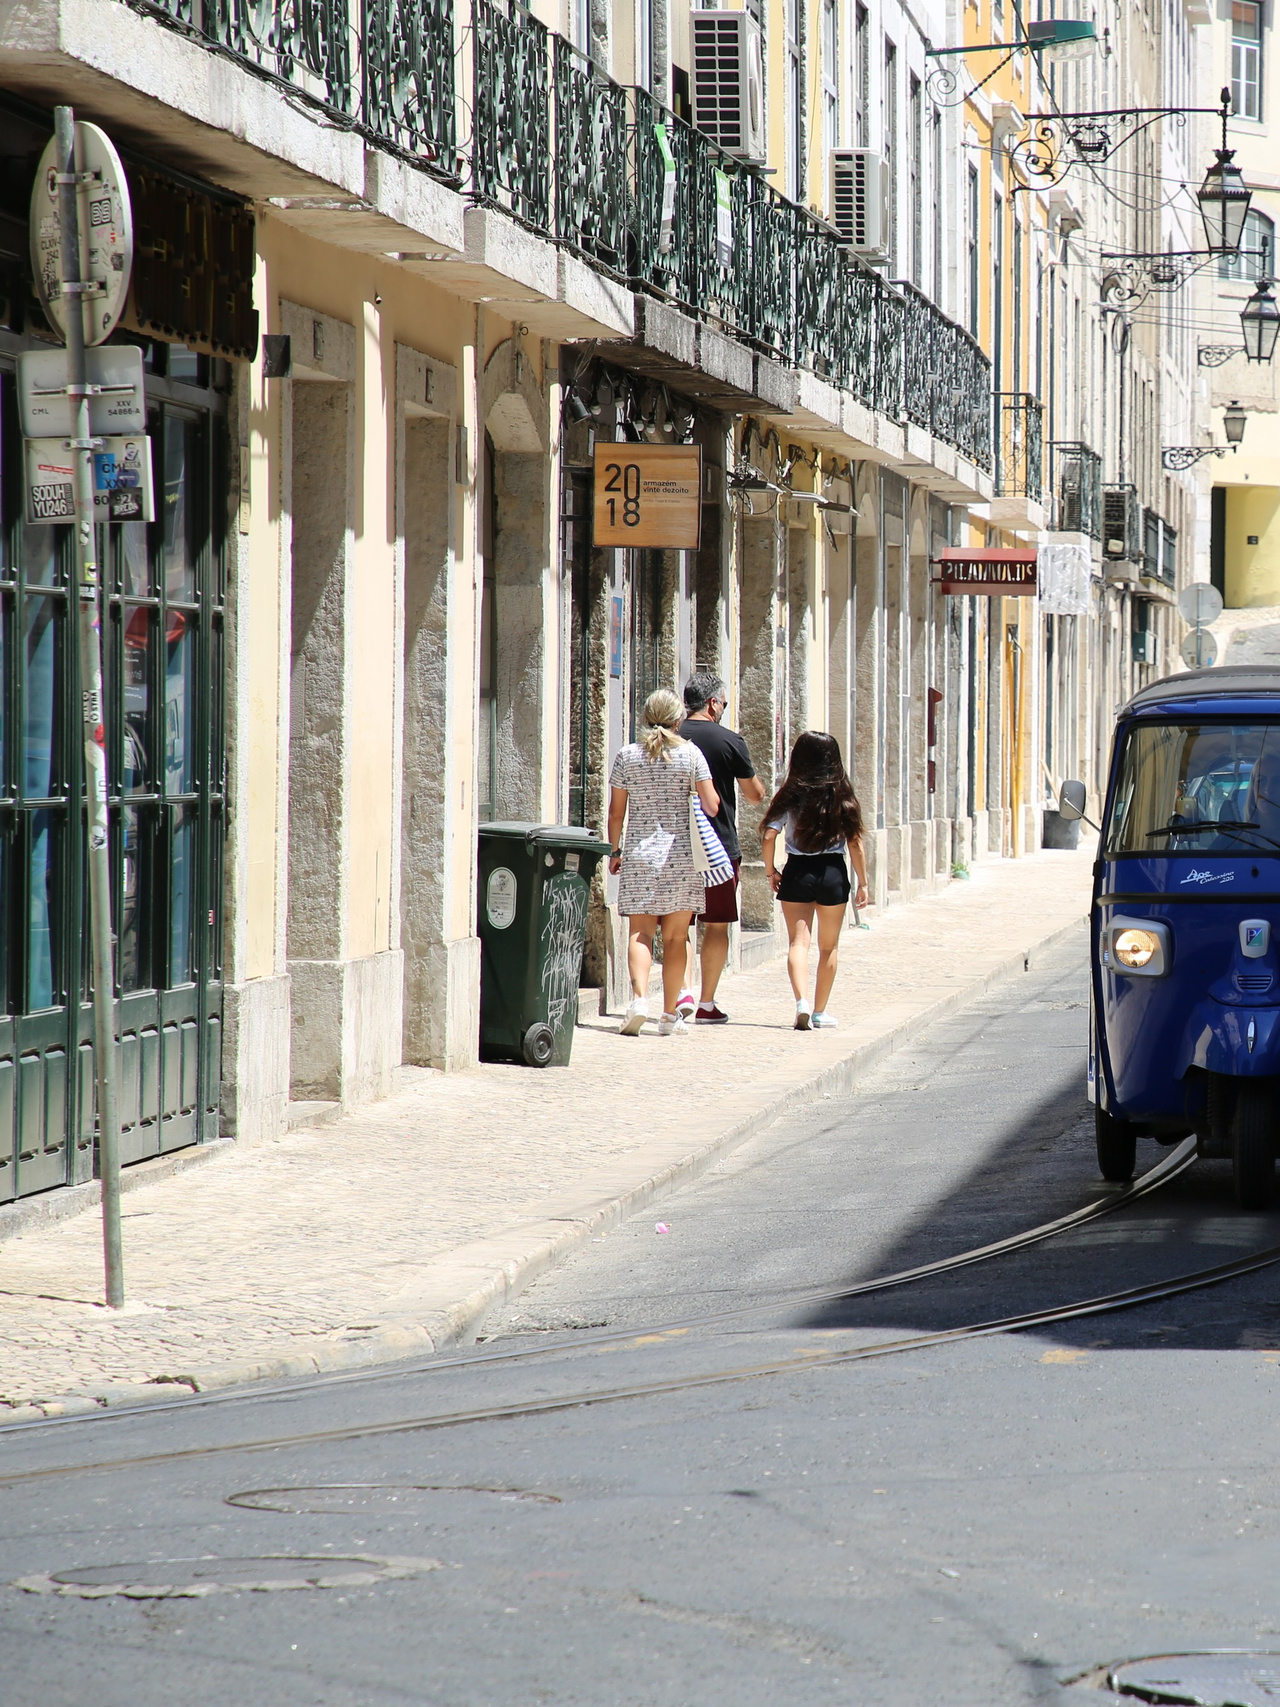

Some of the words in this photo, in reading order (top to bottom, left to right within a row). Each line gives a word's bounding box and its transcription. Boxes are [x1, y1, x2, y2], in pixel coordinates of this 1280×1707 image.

[32, 408, 49, 416] CML
[102, 463, 130, 474] CML
[32, 484, 65, 501] SODUH
[33, 499, 68, 517] YU246
